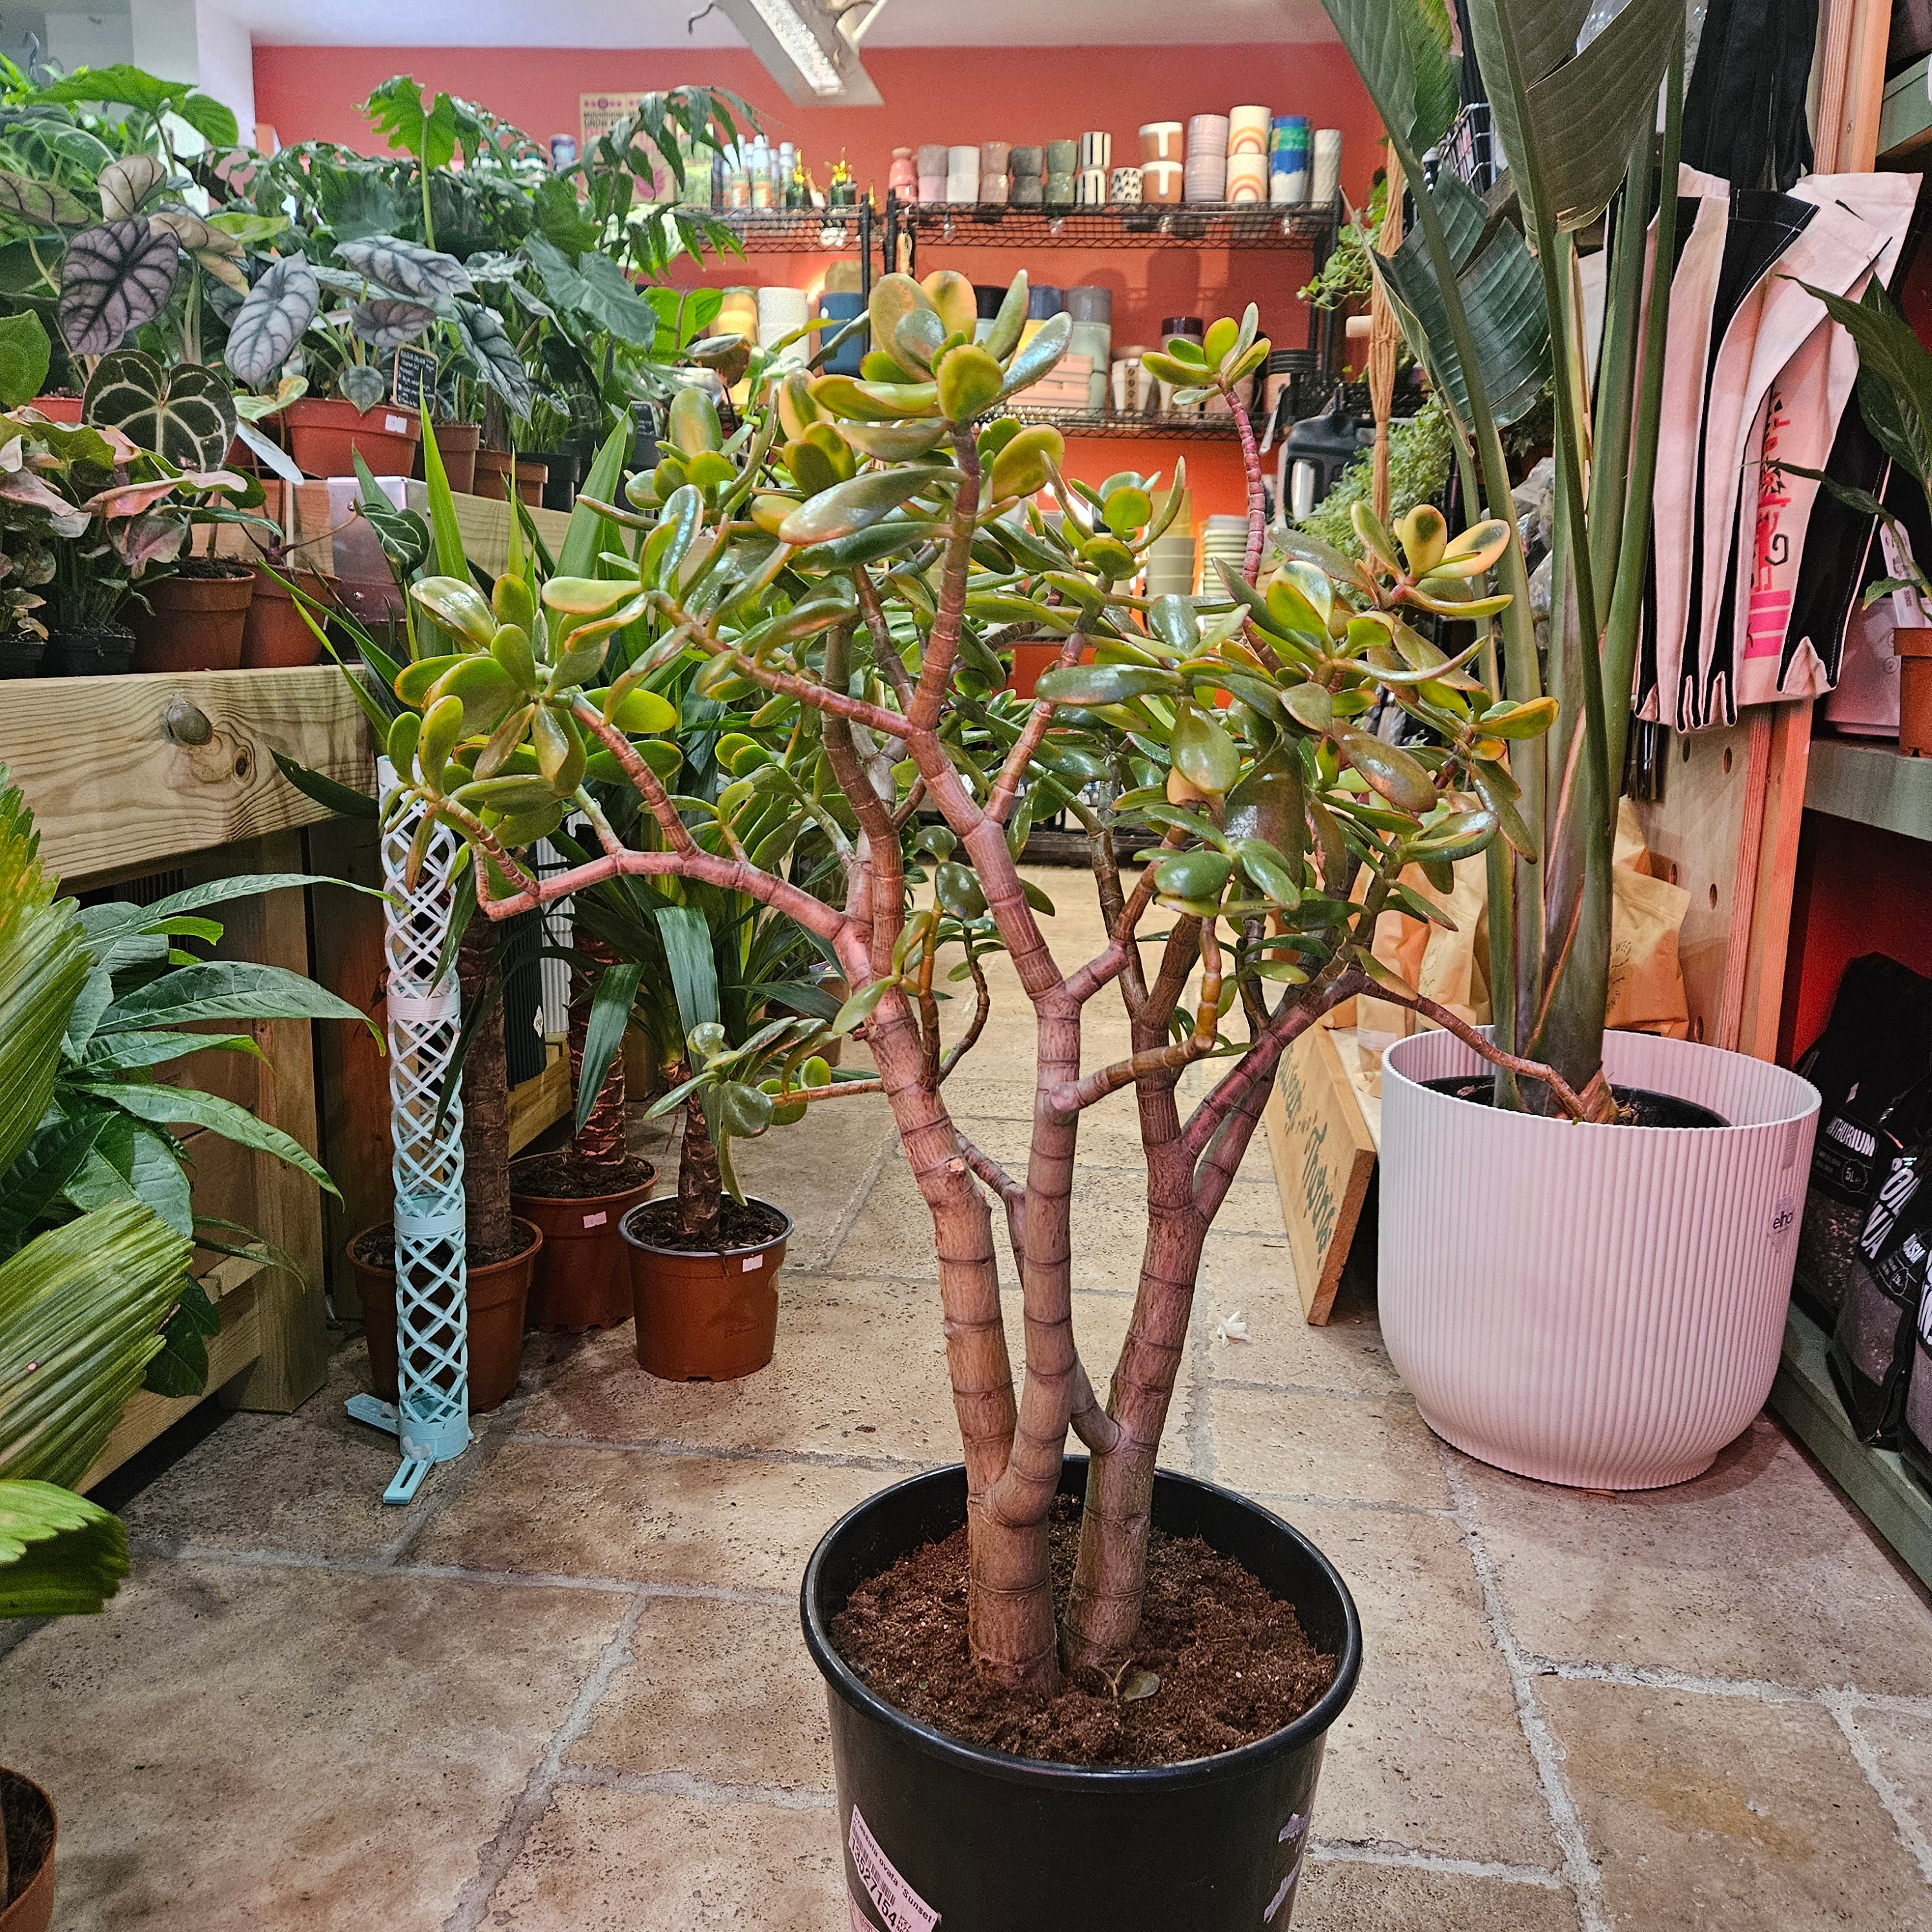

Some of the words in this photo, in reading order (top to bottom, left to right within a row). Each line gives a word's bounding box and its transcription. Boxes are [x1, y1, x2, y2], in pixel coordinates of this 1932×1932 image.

[1773, 1211, 1794, 1229] elho
[854, 1811, 878, 1858] Crassula
[879, 1858, 898, 1886] ovata
